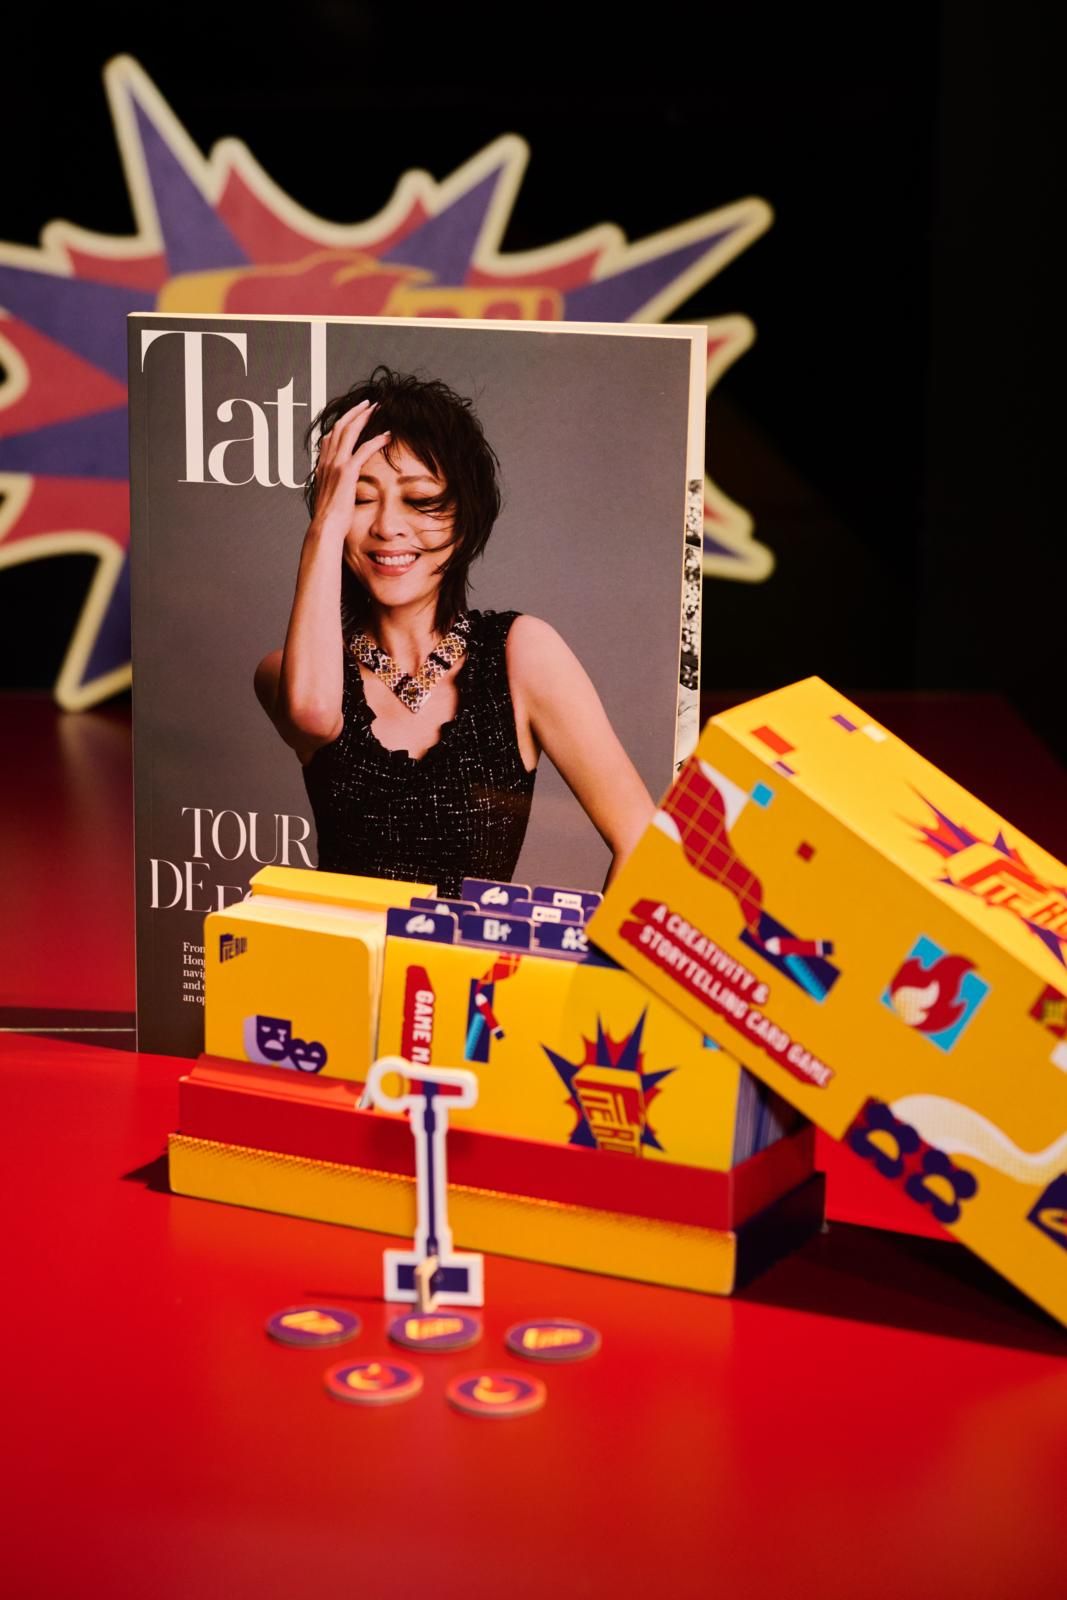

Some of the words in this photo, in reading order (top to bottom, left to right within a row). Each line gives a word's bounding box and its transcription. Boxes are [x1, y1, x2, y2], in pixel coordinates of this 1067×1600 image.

[182, 807, 318, 868] TOUR
[150, 858, 212, 912] DE
[216, 885, 253, 912] F
[183, 954, 206, 968] Hon
[652, 904, 667, 923] A
[666, 914, 755, 990] CREATIVITY
[752, 983, 769, 1004] &
[183, 980, 201, 991] and
[183, 994, 195, 1003] an
[639, 924, 749, 1019] STORYTELLING
[745, 1011, 791, 1052] CARD
[786, 1044, 833, 1086] GAME
[413, 990, 434, 1043] GAME
[411, 1046, 430, 1065] M
